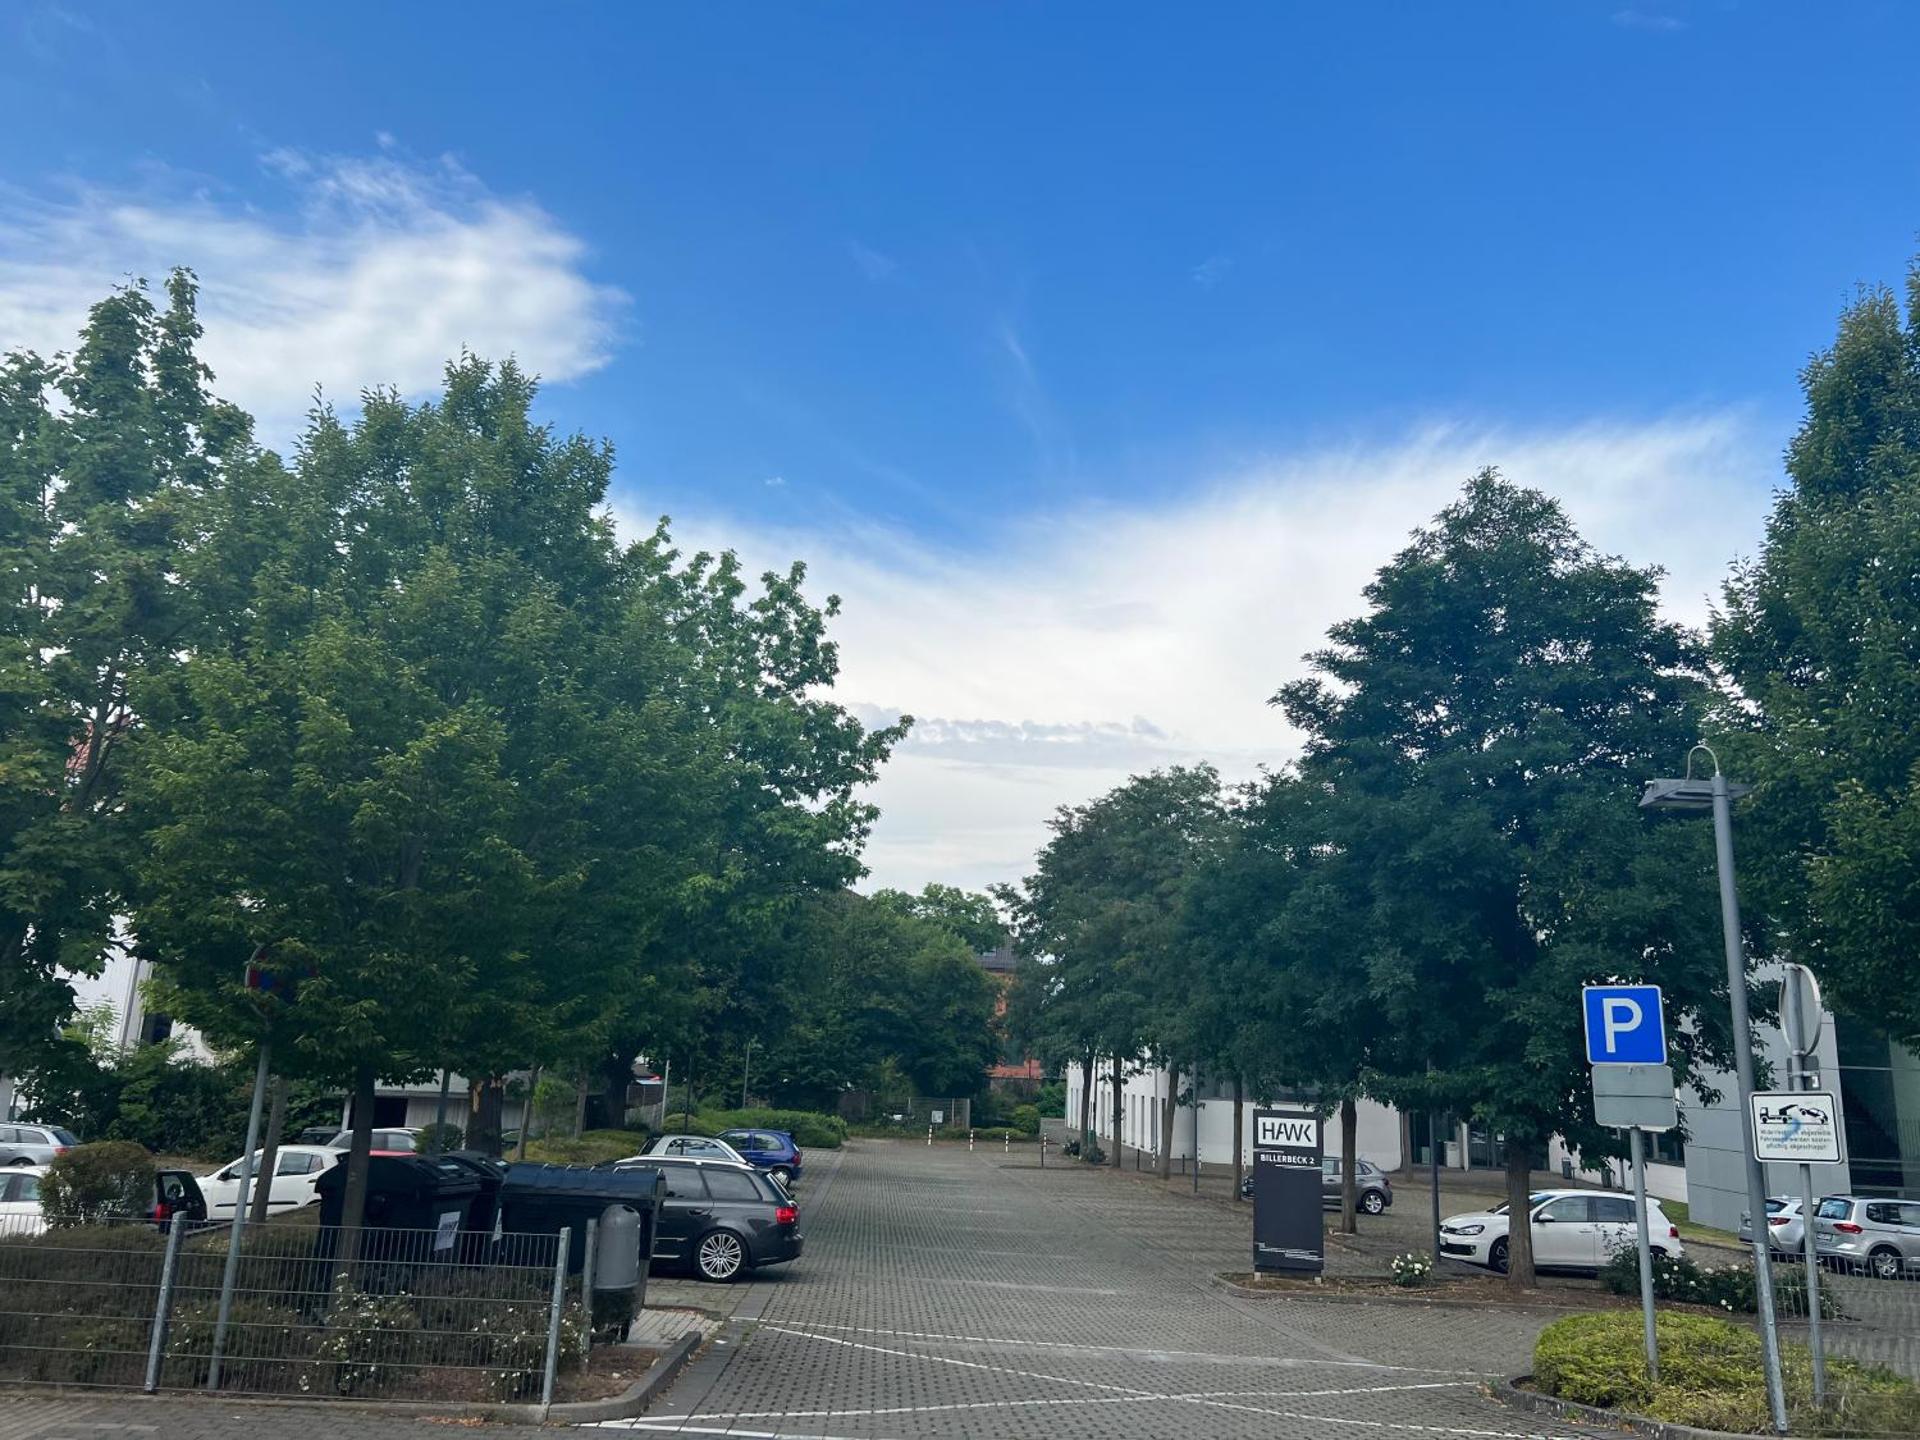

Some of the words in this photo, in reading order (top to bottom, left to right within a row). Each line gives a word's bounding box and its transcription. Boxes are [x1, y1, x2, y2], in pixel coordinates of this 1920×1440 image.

[1602, 998, 1643, 1053] P
[1262, 1121, 1312, 1143] HAWK
[1260, 1154, 1308, 1164] BILLERBECK
